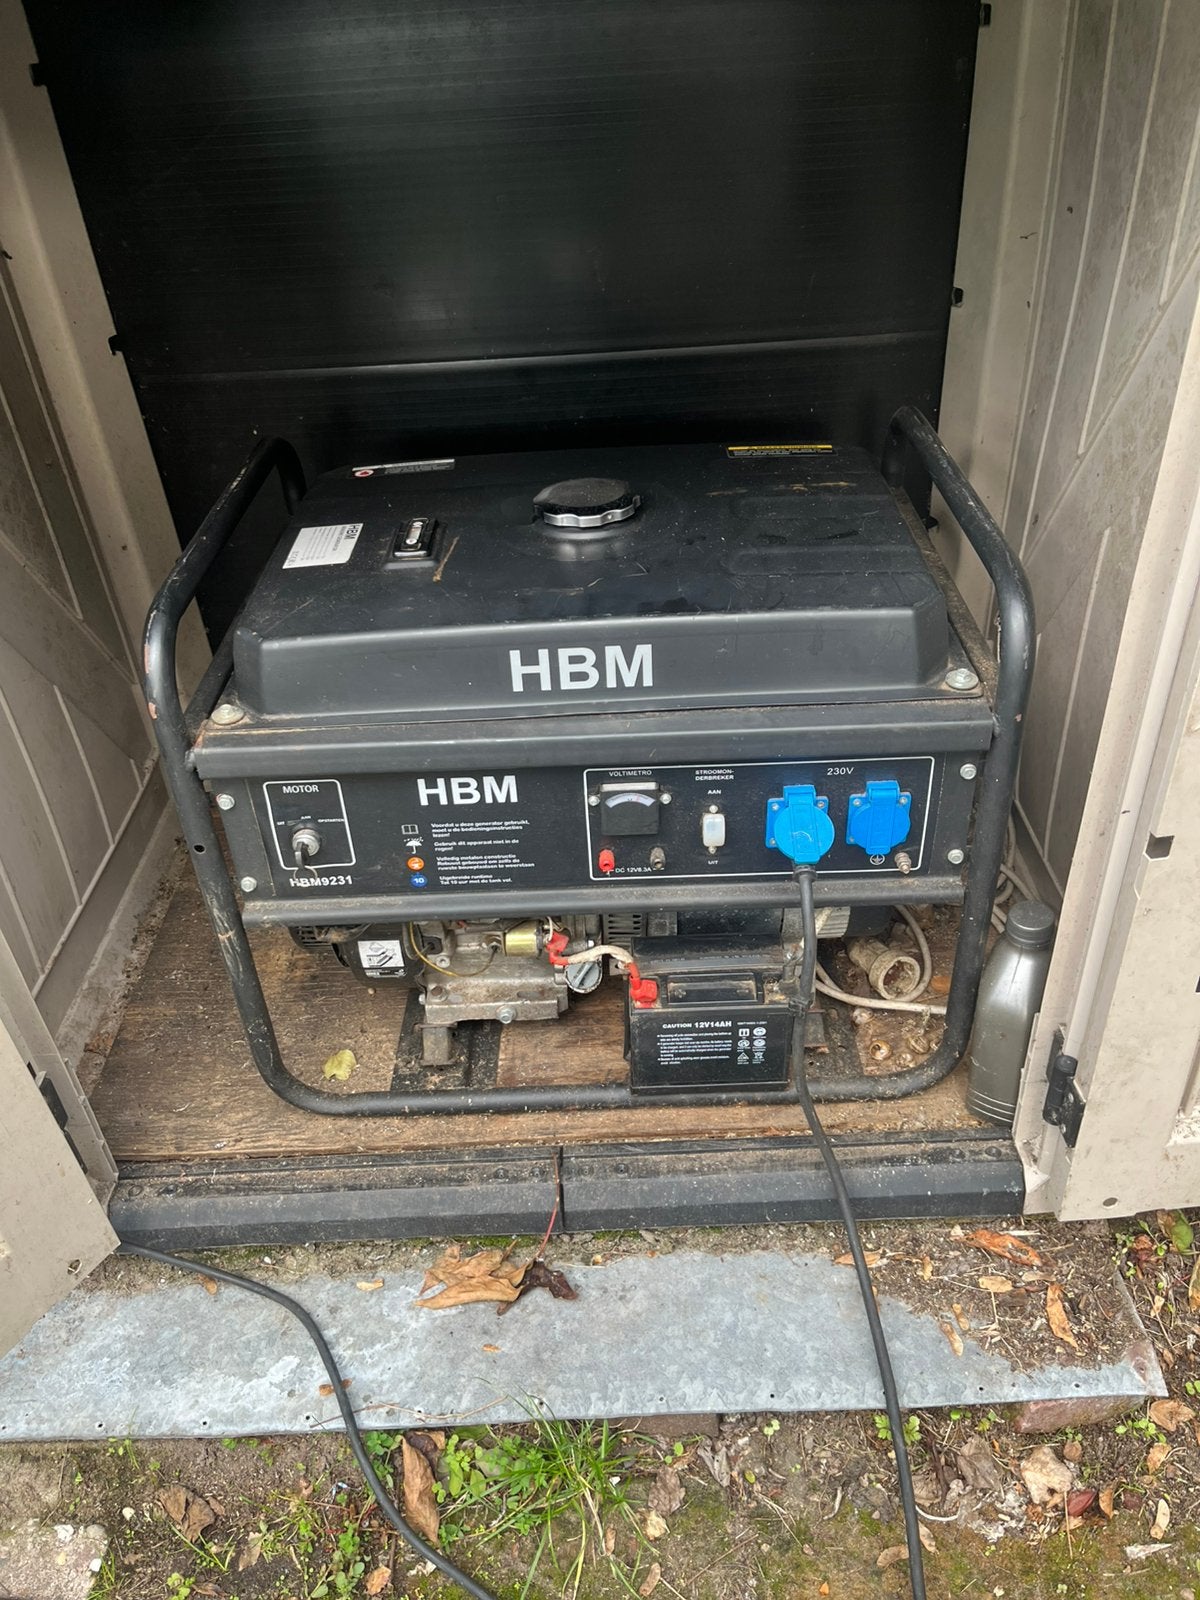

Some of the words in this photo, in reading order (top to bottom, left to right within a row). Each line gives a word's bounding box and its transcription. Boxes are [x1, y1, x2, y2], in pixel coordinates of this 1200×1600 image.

[344, 524, 361, 540] HBM
[509, 644, 653, 692] HBM
[827, 767, 855, 776] 230V
[282, 784, 319, 794] MOTOR
[417, 775, 519, 806] HBM
[289, 875, 353, 887] HBM9231
[694, 1020, 732, 1028] 12V14AH
